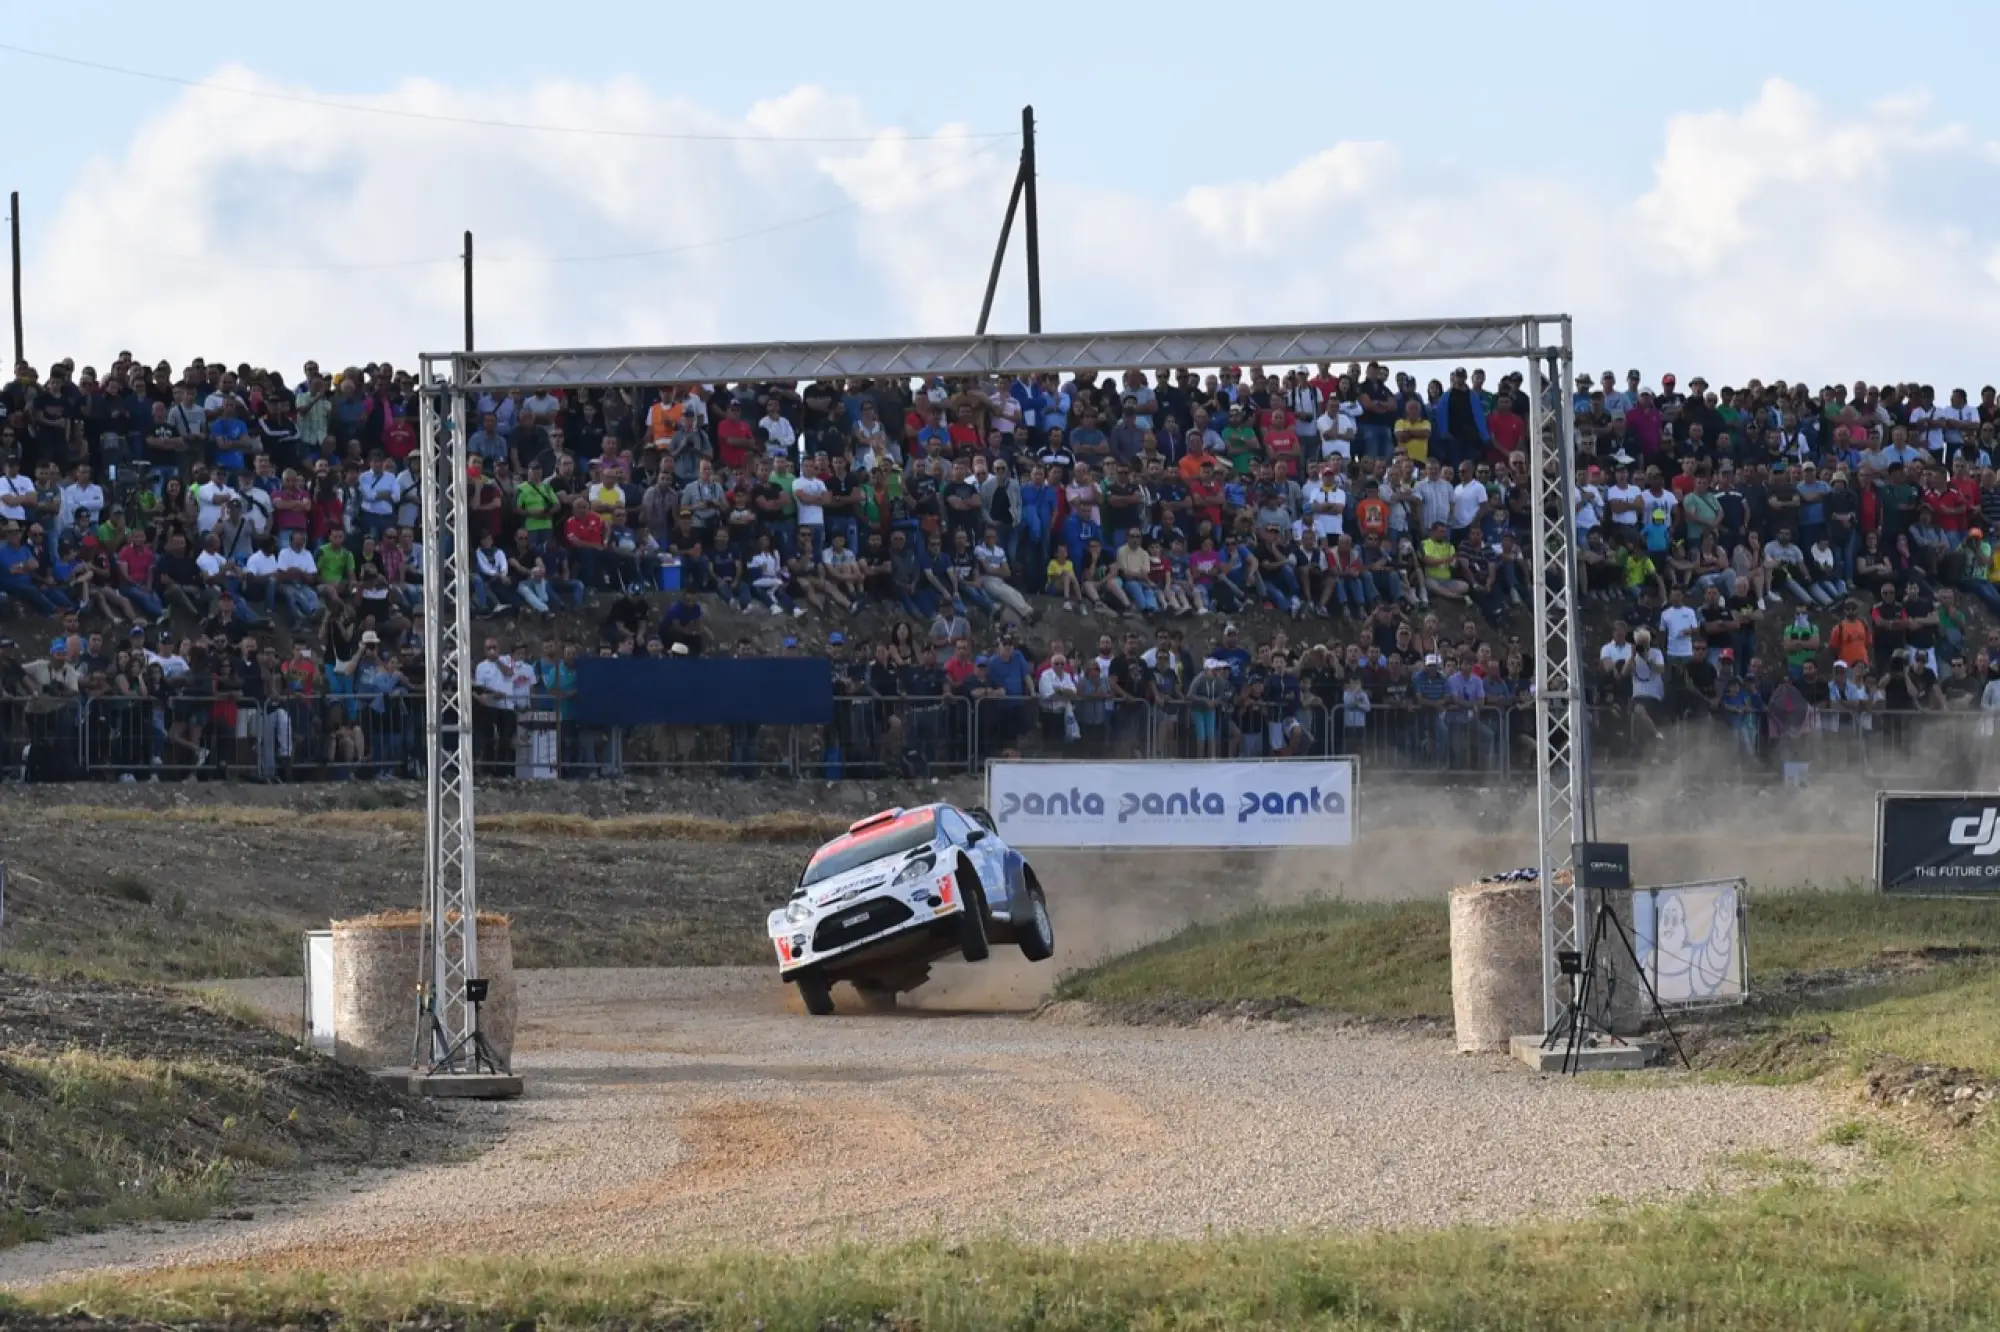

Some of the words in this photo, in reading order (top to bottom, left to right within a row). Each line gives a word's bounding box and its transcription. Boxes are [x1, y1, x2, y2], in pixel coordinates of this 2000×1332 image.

[999, 787, 1104, 823] panta
[1118, 787, 1224, 823] panta
[1238, 786, 1345, 822] panta
[1915, 866, 1937, 877] THE
[1939, 866, 1982, 877] FUTURE
